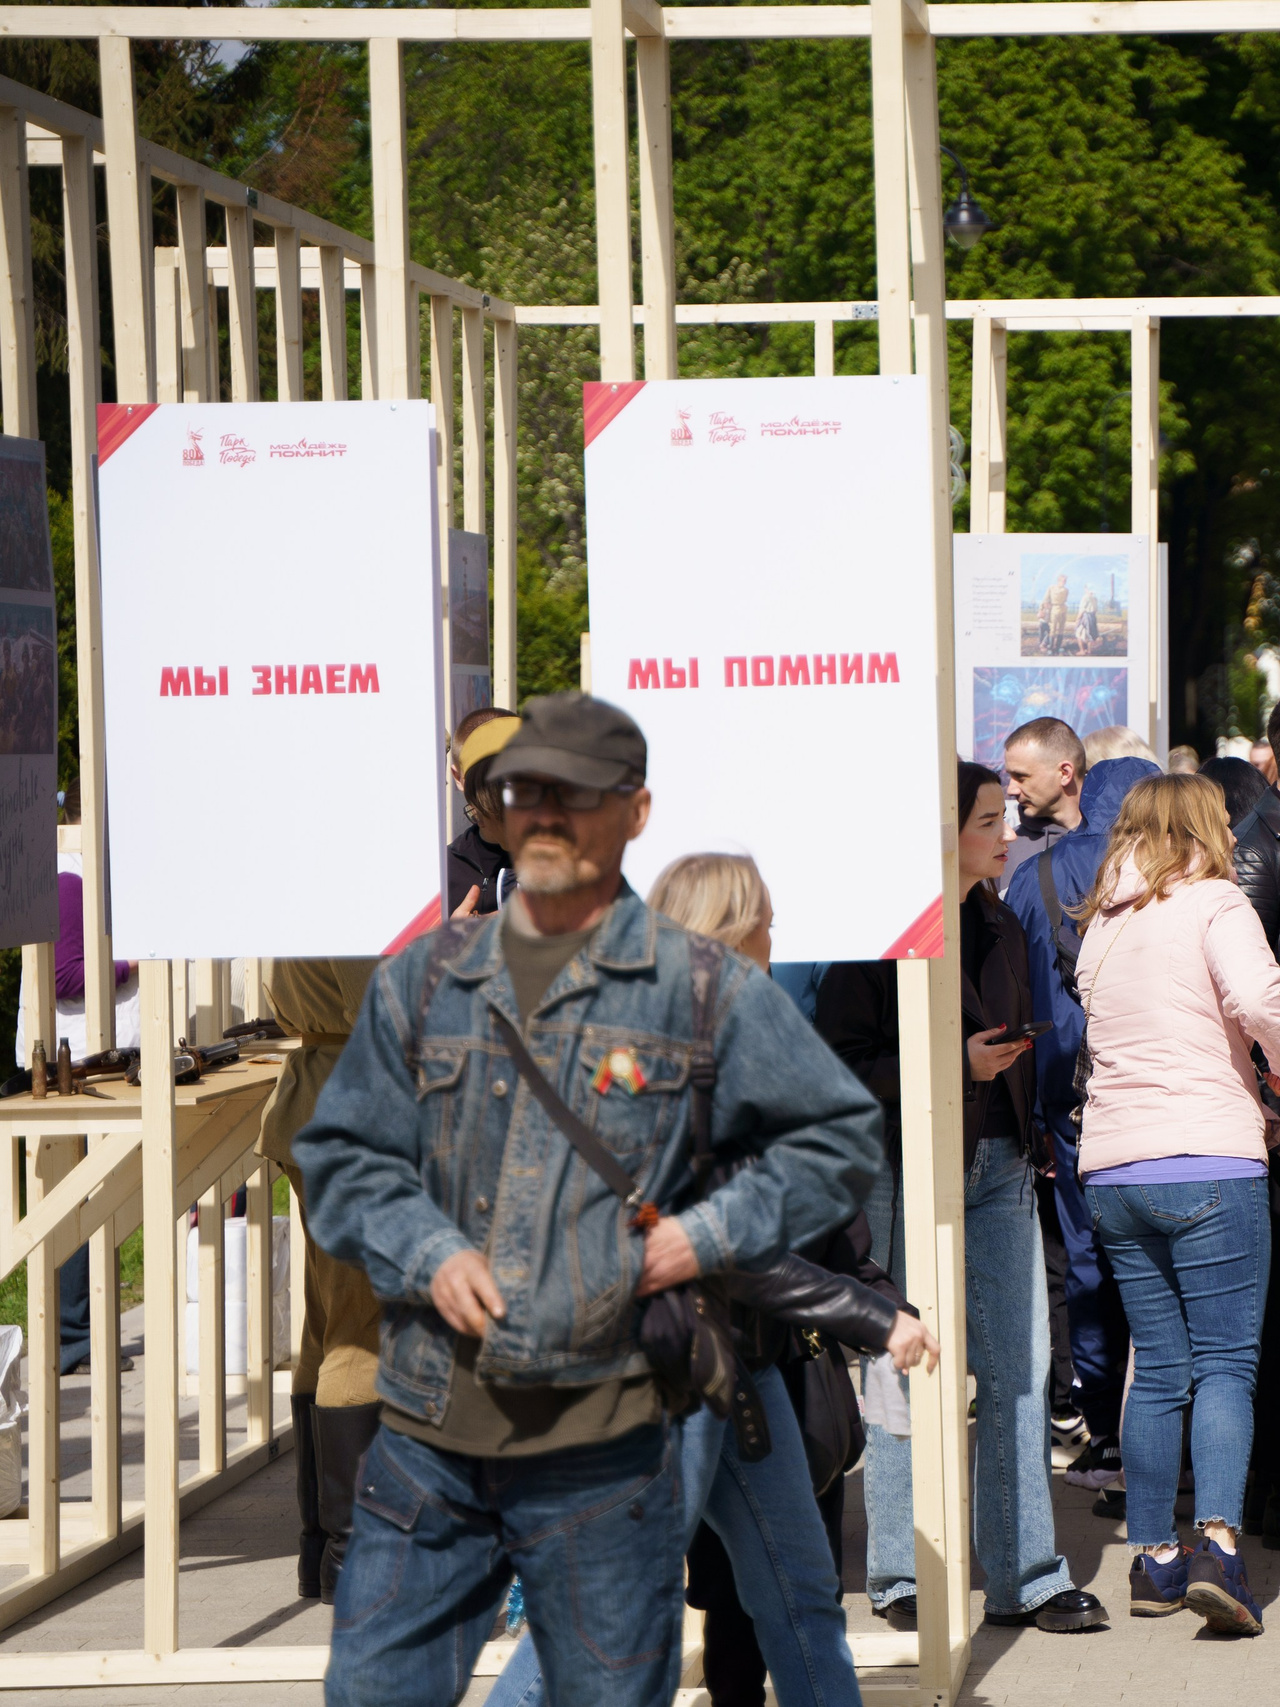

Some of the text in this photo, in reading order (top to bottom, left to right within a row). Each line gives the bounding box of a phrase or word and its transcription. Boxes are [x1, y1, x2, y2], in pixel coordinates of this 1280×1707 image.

[709, 411, 738, 429] Парк
[761, 428, 841, 436] ПОМНИТ
[220, 434, 249, 451] Парк
[270, 450, 347, 458] ПОМНИТ
[628, 652, 900, 690] МЫ ПОМНИМ
[160, 664, 380, 697] МЫ ЗНАЕМ
